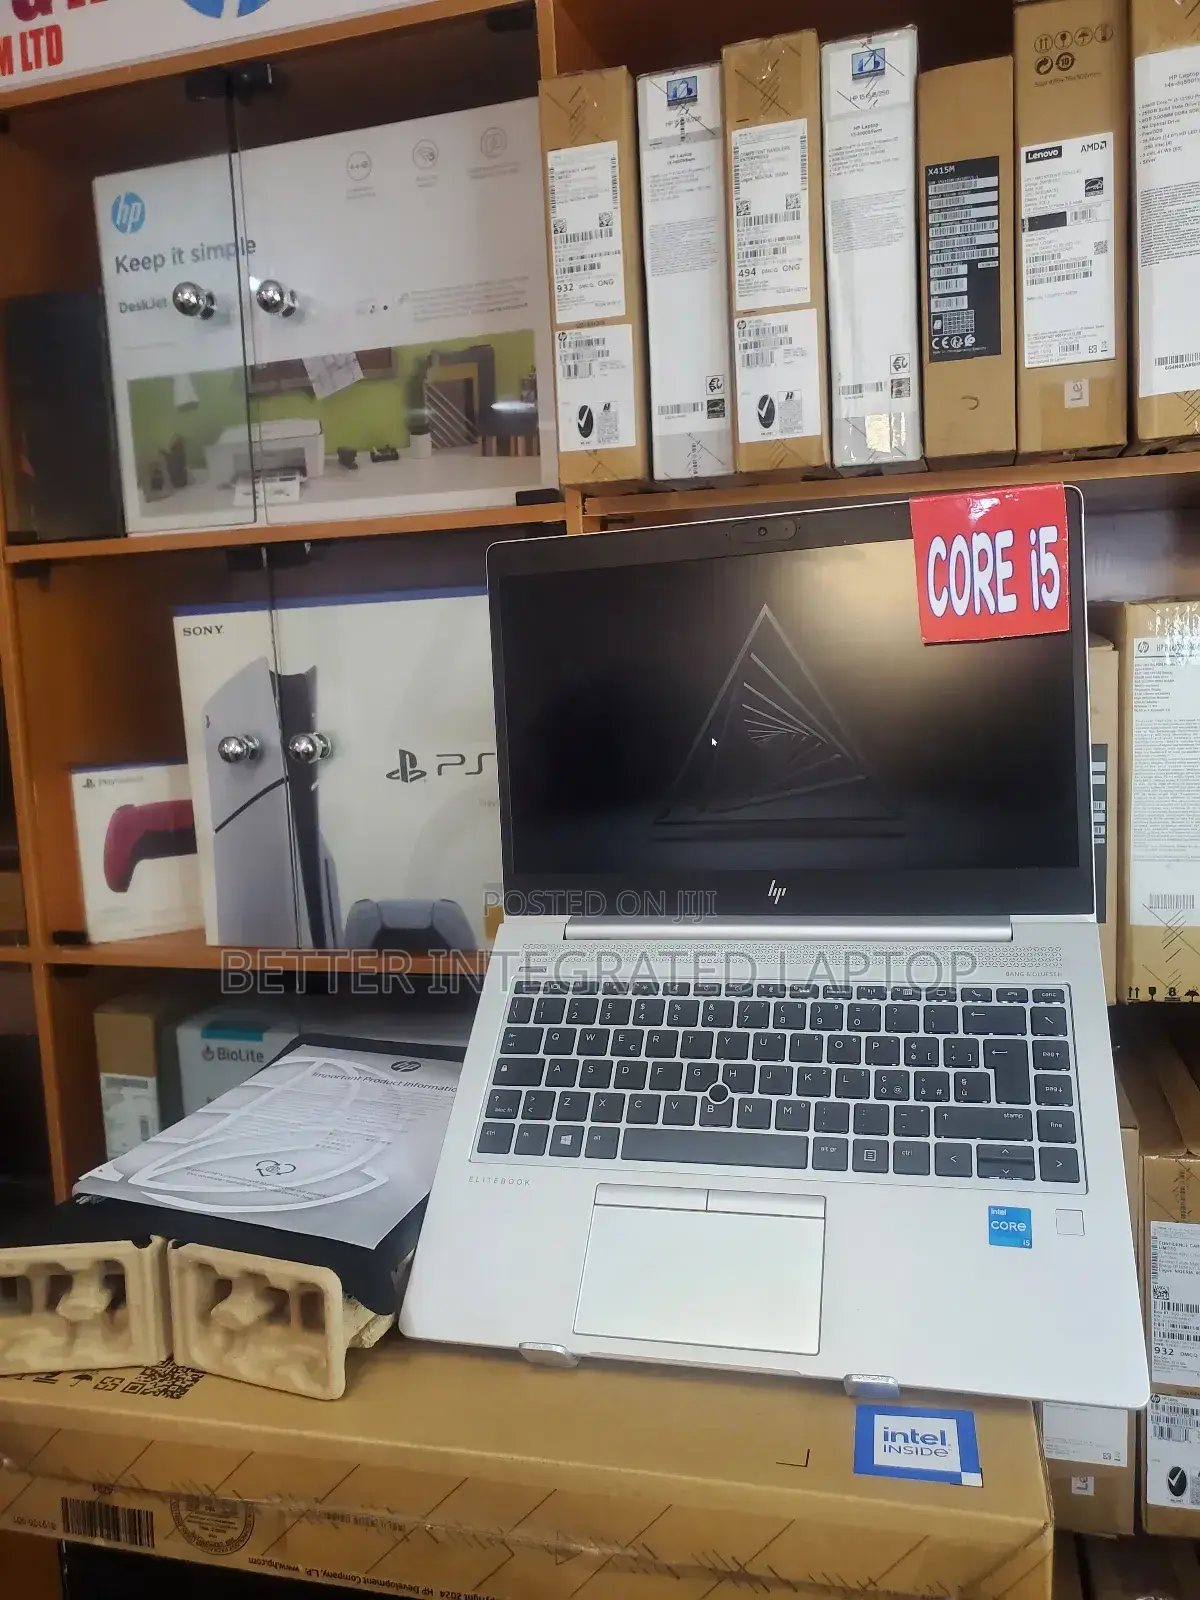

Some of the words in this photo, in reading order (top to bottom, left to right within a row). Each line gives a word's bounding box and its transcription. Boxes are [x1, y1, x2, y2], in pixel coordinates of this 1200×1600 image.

[19, 24, 64, 72] LTD
[1179, 71, 1200, 79] Laptop
[1028, 149, 1059, 160] Lenovo
[1081, 142, 1100, 153] AMD
[928, 165, 956, 176] X415M
[112, 191, 146, 234] hp
[115, 252, 166, 274] Keep
[172, 246, 184, 266] it
[191, 236, 256, 264] simple
[738, 268, 756, 278] 494
[782, 264, 800, 272] ONG
[556, 283, 574, 292] 932
[598, 278, 614, 287] ONG
[119, 296, 167, 314] DeskJet
[926, 529, 1018, 618] CORE
[1028, 525, 1061, 612] i5
[183, 624, 224, 637] SONY
[436, 752, 496, 776] PS
[768, 880, 786, 904] hp
[1168, 987, 1176, 997] 8
[217, 1047, 264, 1062] BioLite
[312, 1072, 361, 1082] Important
[363, 1076, 402, 1086] Product
[404, 1082, 457, 1092] Informatio
[468, 1176, 531, 1186] ELITEBOOK
[1154, 1346, 1174, 1356] 932
[883, 1426, 948, 1446] intel
[248, 1556, 300, 1574] www.hp.com
[322, 1570, 361, 1585] Company,
[362, 1576, 420, 1594] Development
[421, 1586, 434, 1597] HP
[440, 1588, 462, 1600] 2024
